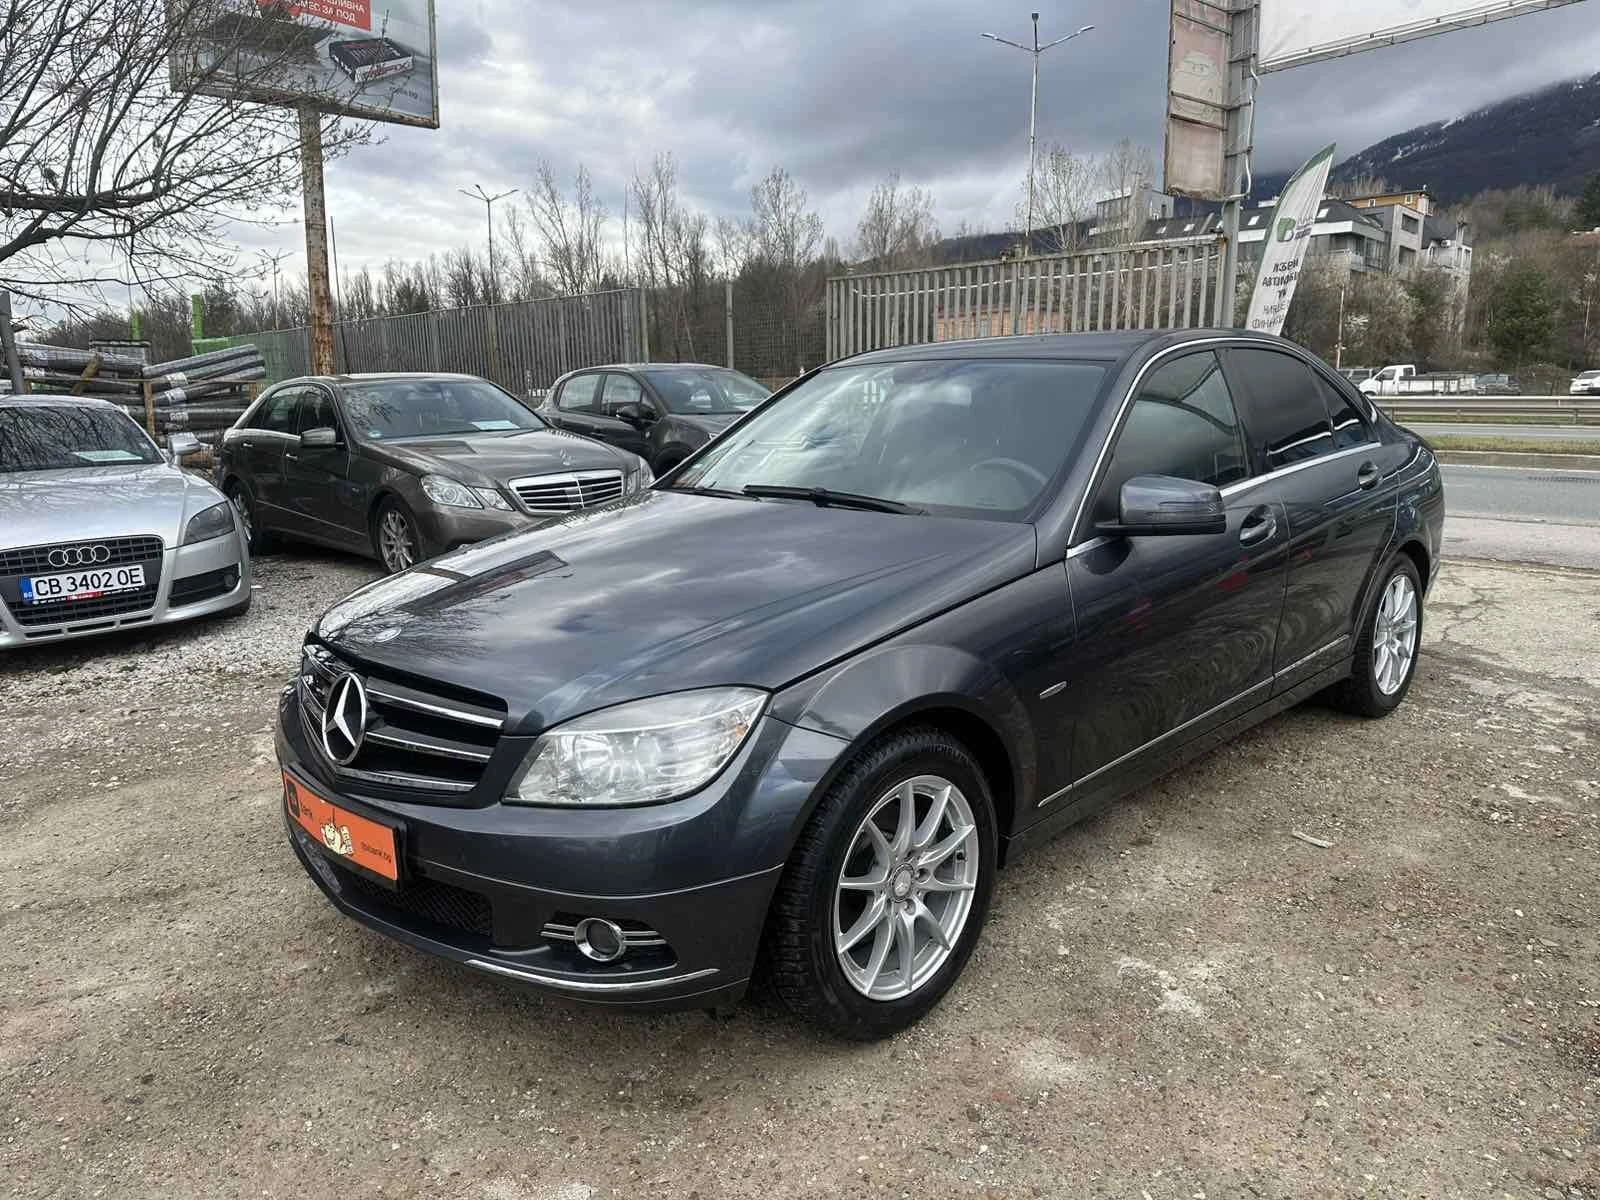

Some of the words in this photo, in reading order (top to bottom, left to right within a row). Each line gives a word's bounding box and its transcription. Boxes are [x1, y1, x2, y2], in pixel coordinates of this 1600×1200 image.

[336, 9, 357, 24] ПОД
[35, 578, 62, 596] CB
[66, 571, 114, 592] 3402
[117, 567, 142, 585] OE
